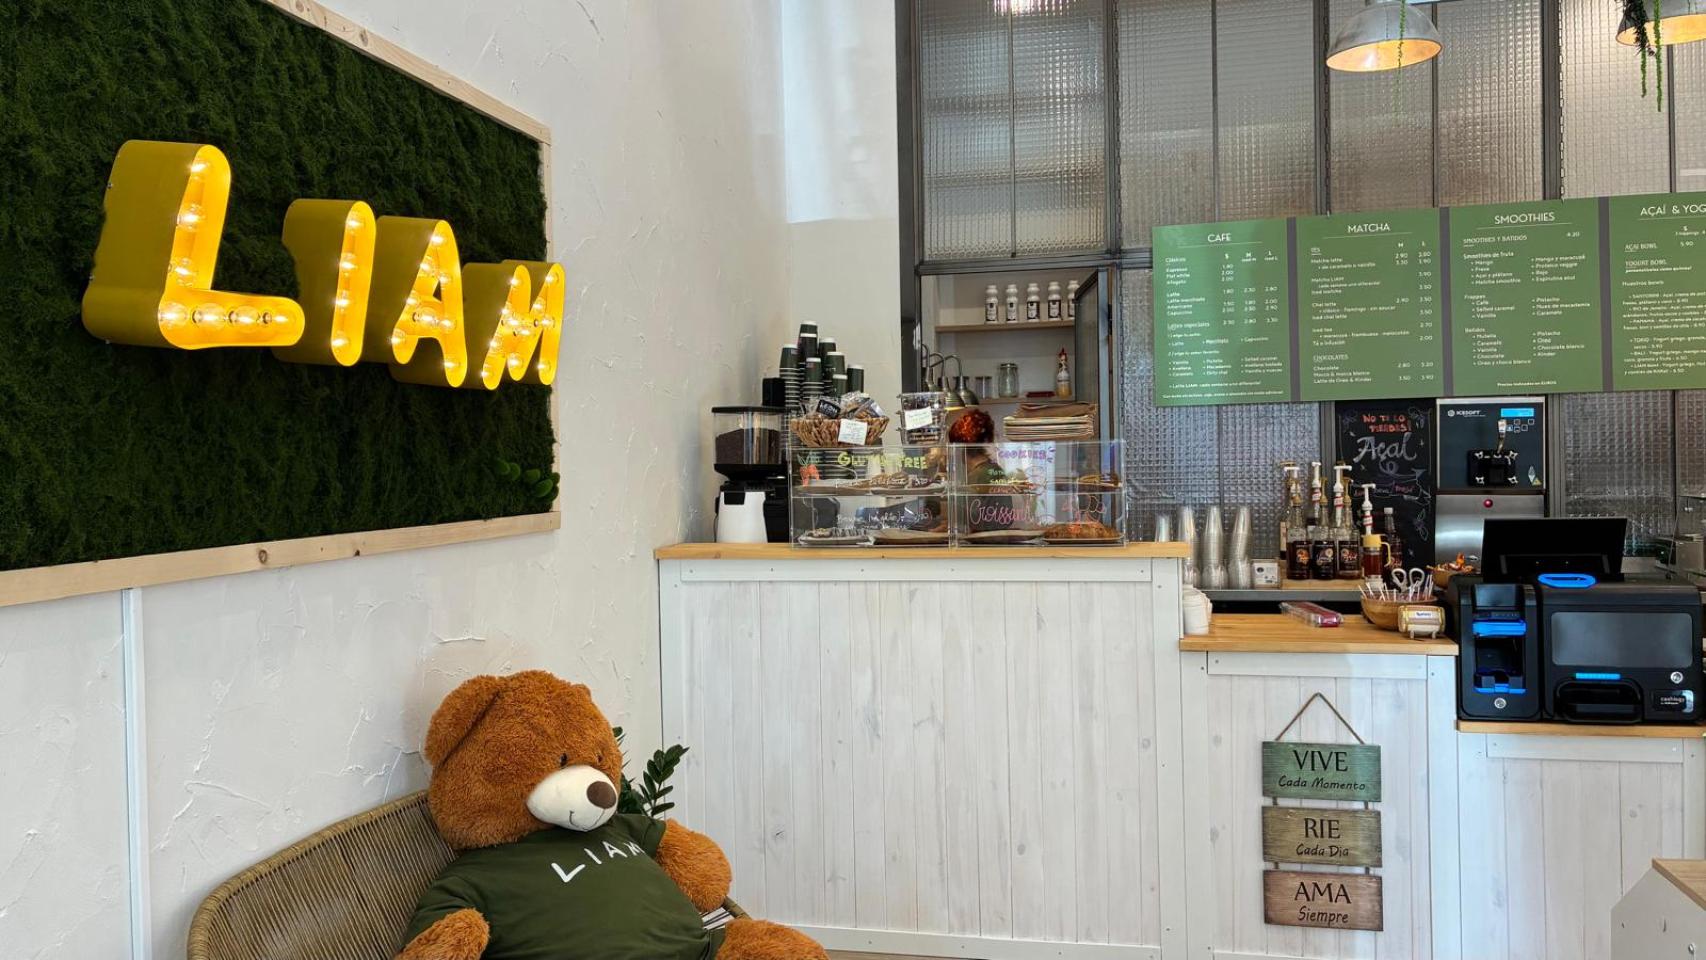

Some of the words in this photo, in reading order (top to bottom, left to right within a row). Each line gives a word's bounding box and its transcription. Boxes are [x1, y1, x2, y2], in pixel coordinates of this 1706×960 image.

[1494, 212, 1556, 224] SMOOTHIES
[1672, 205, 1680, 214] &
[1348, 223, 1390, 233] MATCHA
[158, 142, 565, 391] LIAM
[1293, 750, 1348, 772] VIVE
[1278, 775, 1307, 788] Cada
[1312, 777, 1366, 791] Momento
[1304, 818, 1341, 839] RIE
[1296, 843, 1325, 857] Cada
[1294, 882, 1352, 904] AMA
[1298, 905, 1349, 926] Siempre
